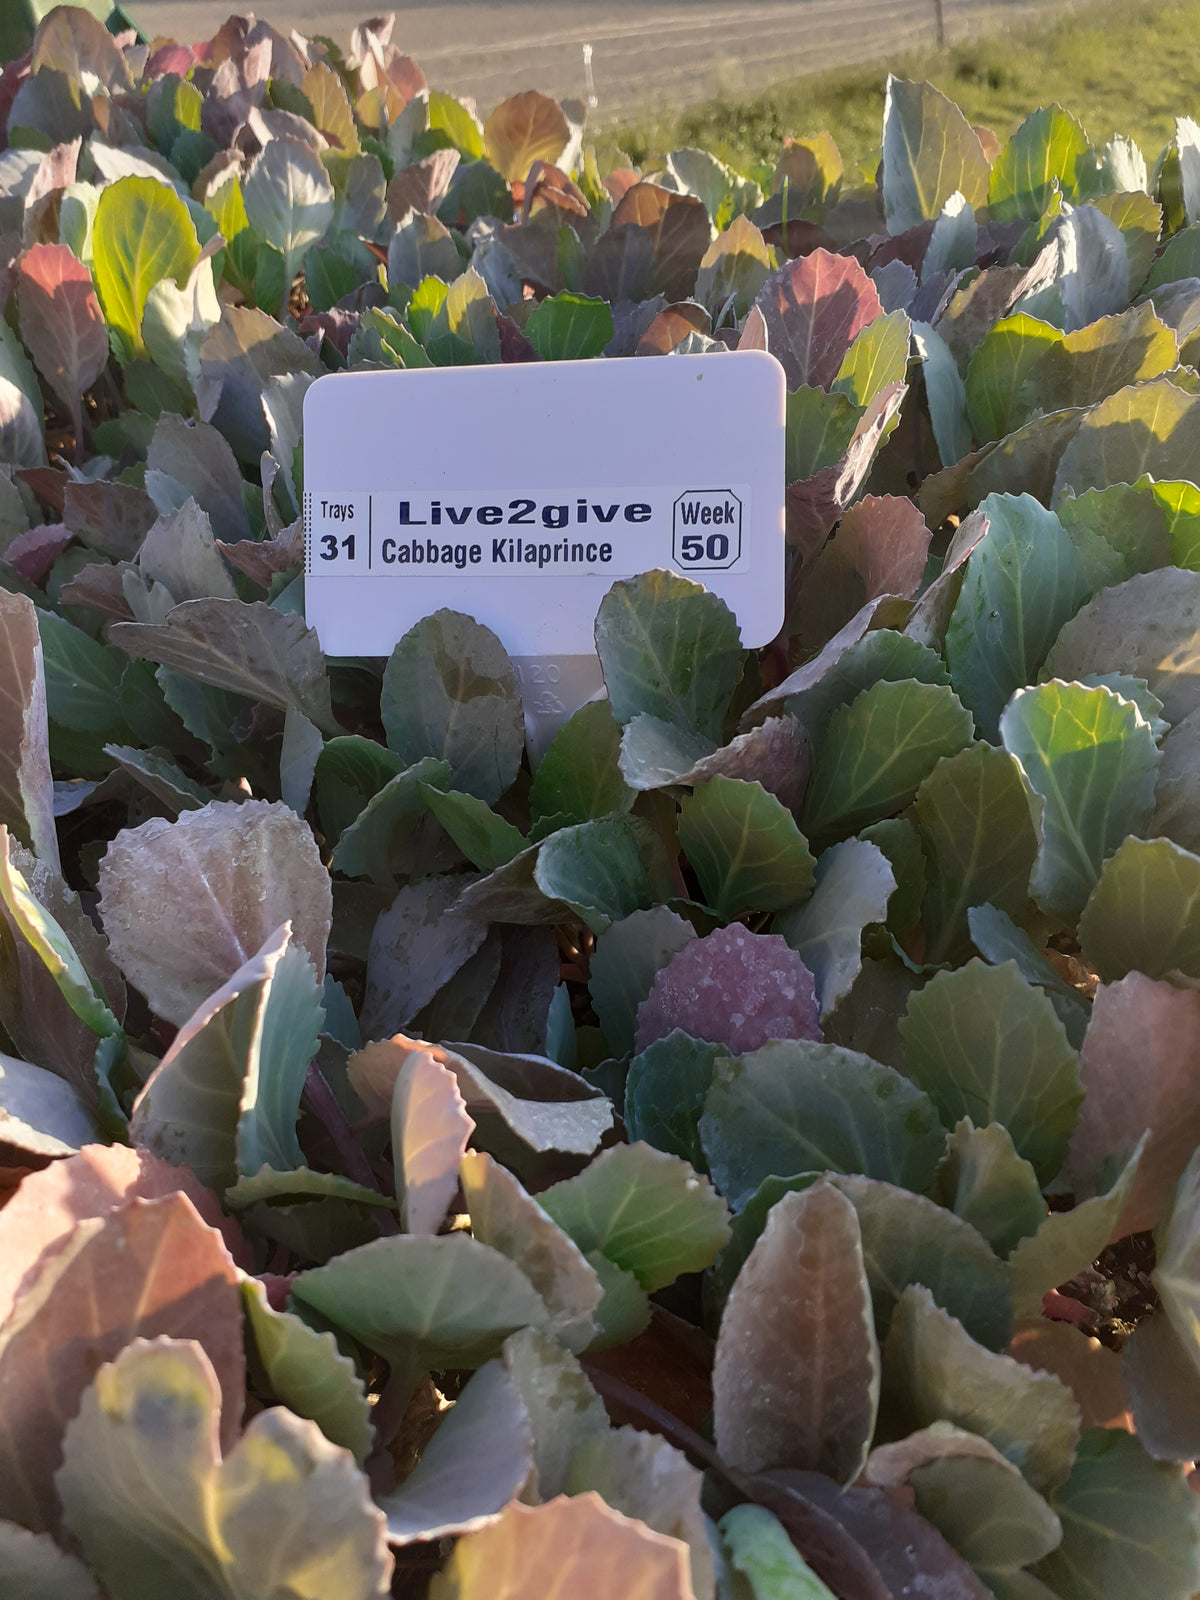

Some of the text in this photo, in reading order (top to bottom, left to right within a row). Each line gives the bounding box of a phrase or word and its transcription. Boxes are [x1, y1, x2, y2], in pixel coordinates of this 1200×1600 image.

[320, 500, 354, 523] Trays
[399, 499, 652, 529] Live2give
[681, 501, 735, 526] Week
[320, 534, 356, 561] 31
[382, 537, 613, 569] Cabbage Kilaprince
[681, 533, 729, 562] 50
